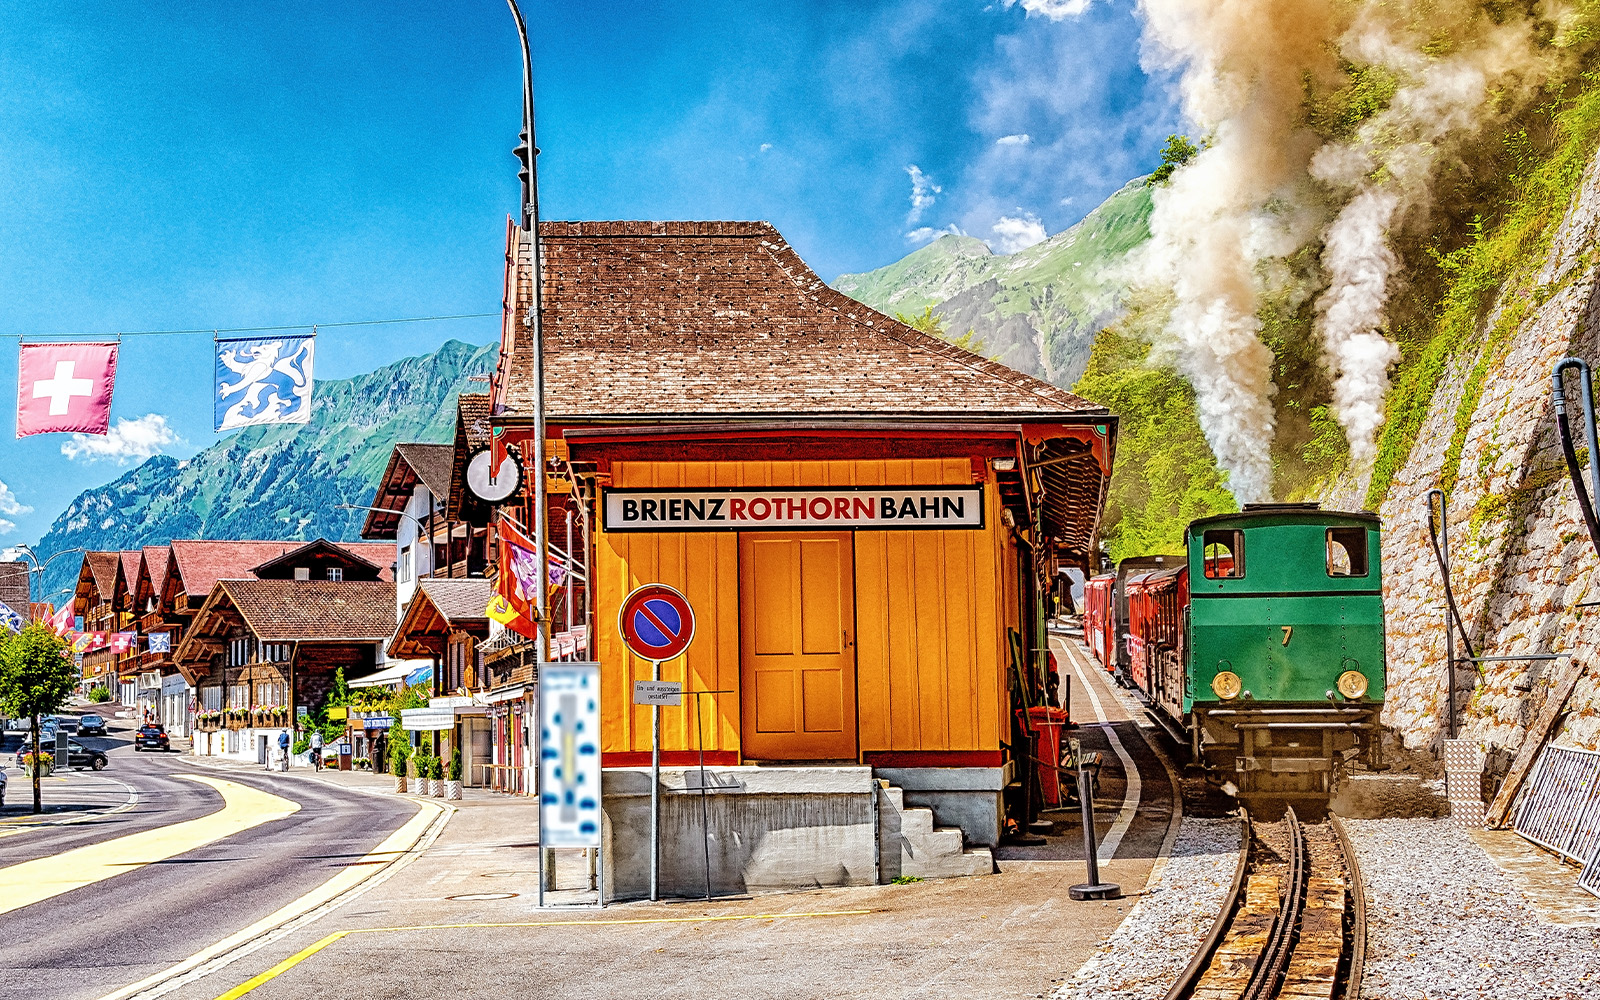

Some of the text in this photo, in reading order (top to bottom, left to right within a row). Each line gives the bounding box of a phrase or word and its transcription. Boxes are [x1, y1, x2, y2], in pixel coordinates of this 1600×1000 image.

[622, 496, 964, 521] BRIENZ ROTHORN BAHN
[1281, 625, 1293, 647] 7
